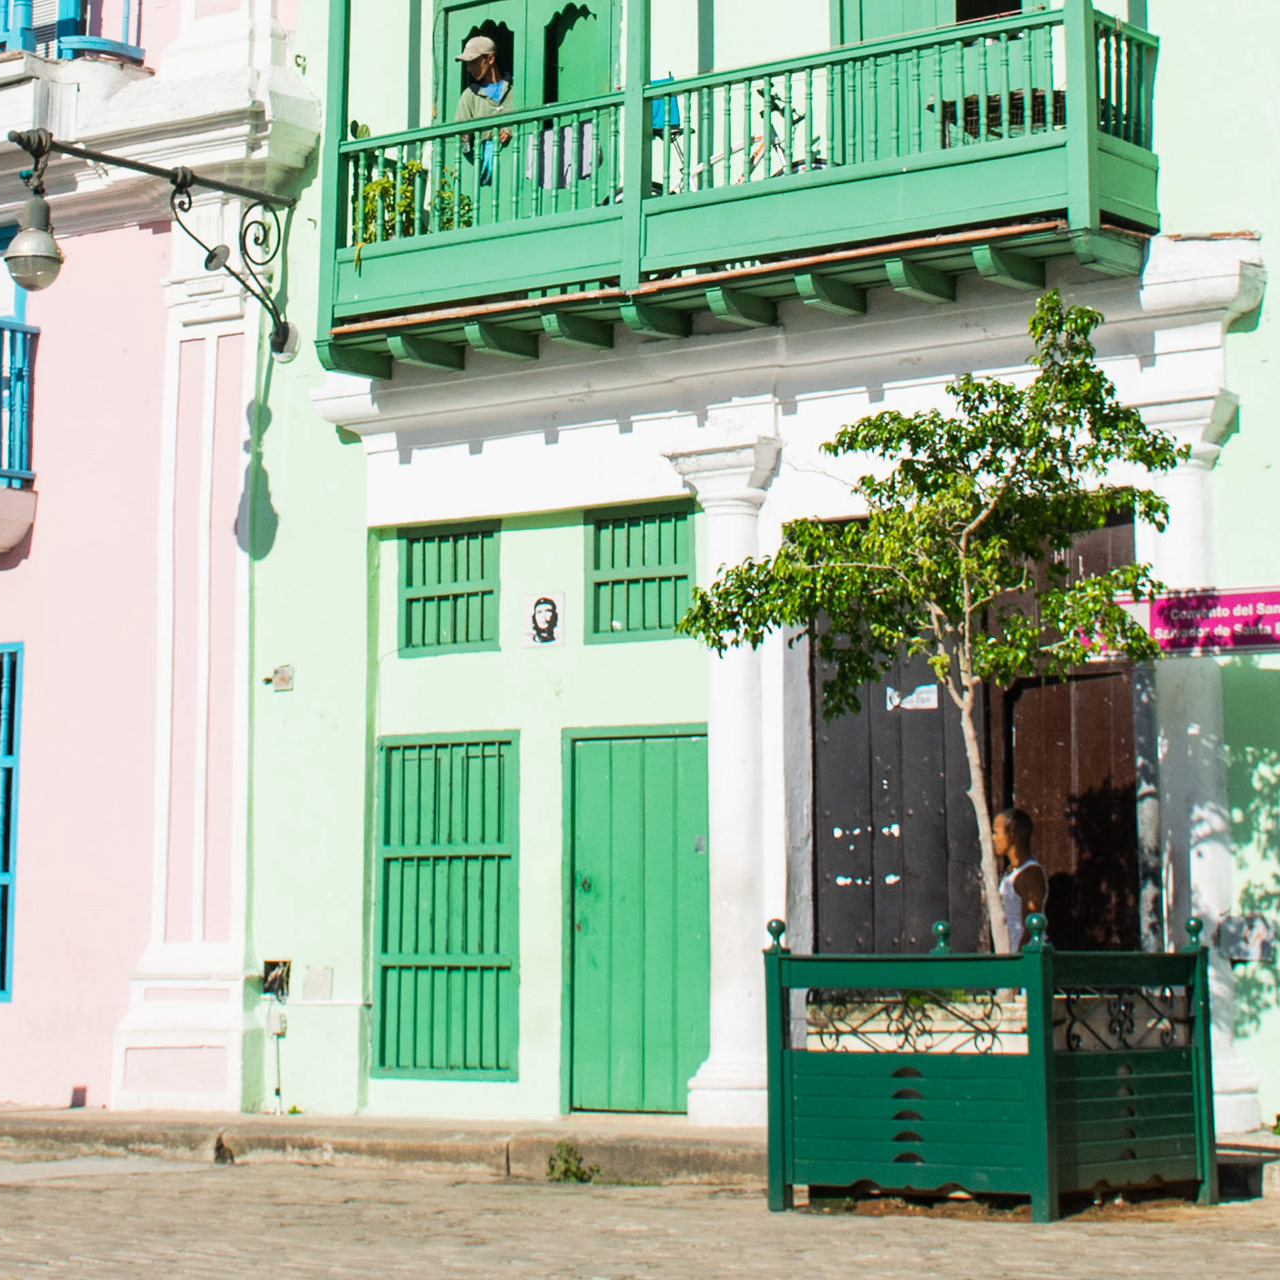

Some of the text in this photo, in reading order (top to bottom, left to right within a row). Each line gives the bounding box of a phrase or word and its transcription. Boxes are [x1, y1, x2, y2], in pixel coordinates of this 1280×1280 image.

[1170, 607, 1230, 621] Convento
[1232, 603, 1253, 617] del
[1213, 624, 1231, 638] de
[1233, 622, 1272, 637] Santa
